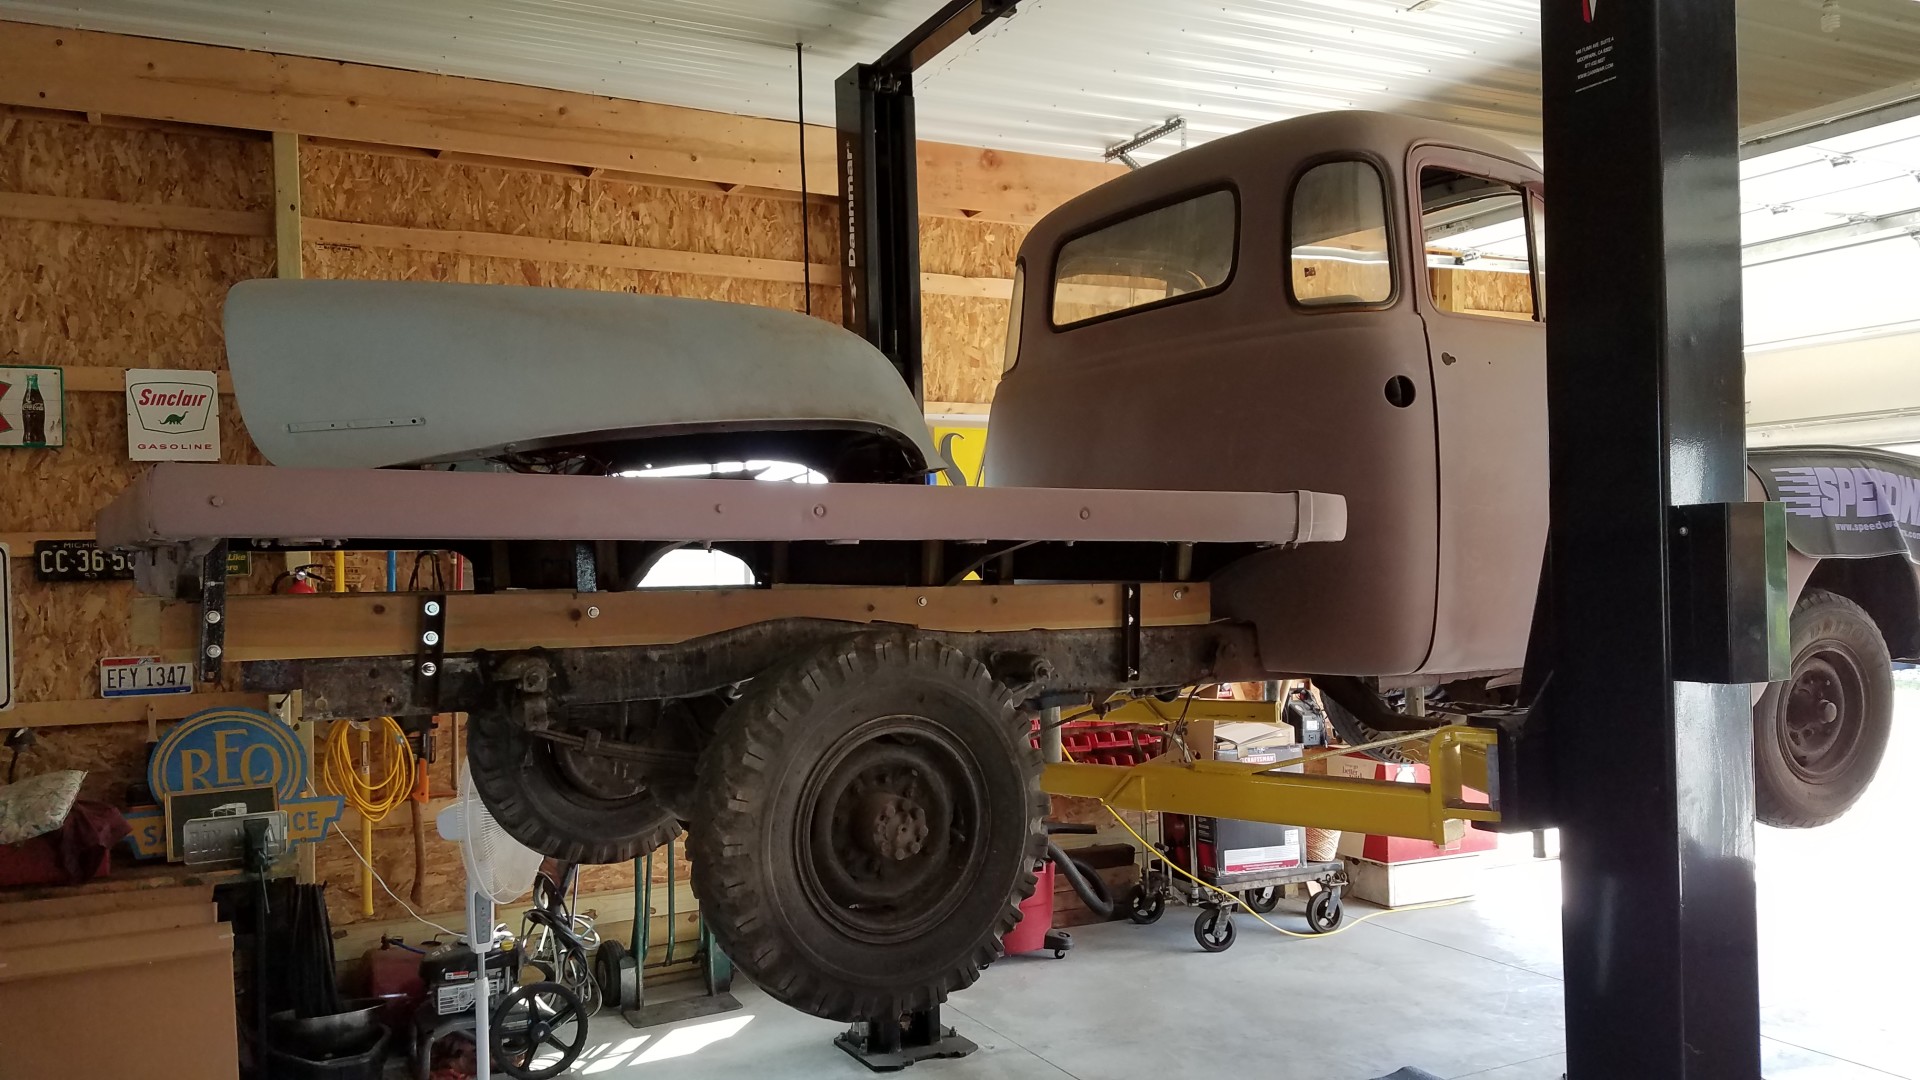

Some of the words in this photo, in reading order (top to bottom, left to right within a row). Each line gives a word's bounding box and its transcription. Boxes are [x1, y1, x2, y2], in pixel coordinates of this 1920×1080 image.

[846, 148, 856, 267] Dannmar
[138, 388, 207, 407] Sinclair
[137, 443, 213, 451] GASOLINE
[1813, 467, 1920, 526] SPEEDW
[107, 667, 138, 689] EFY
[146, 665, 187, 687] 1347
[180, 728, 283, 791] REO
[1244, 756, 1274, 764] CRAFTSMAN
[1342, 765, 1358, 775] better
